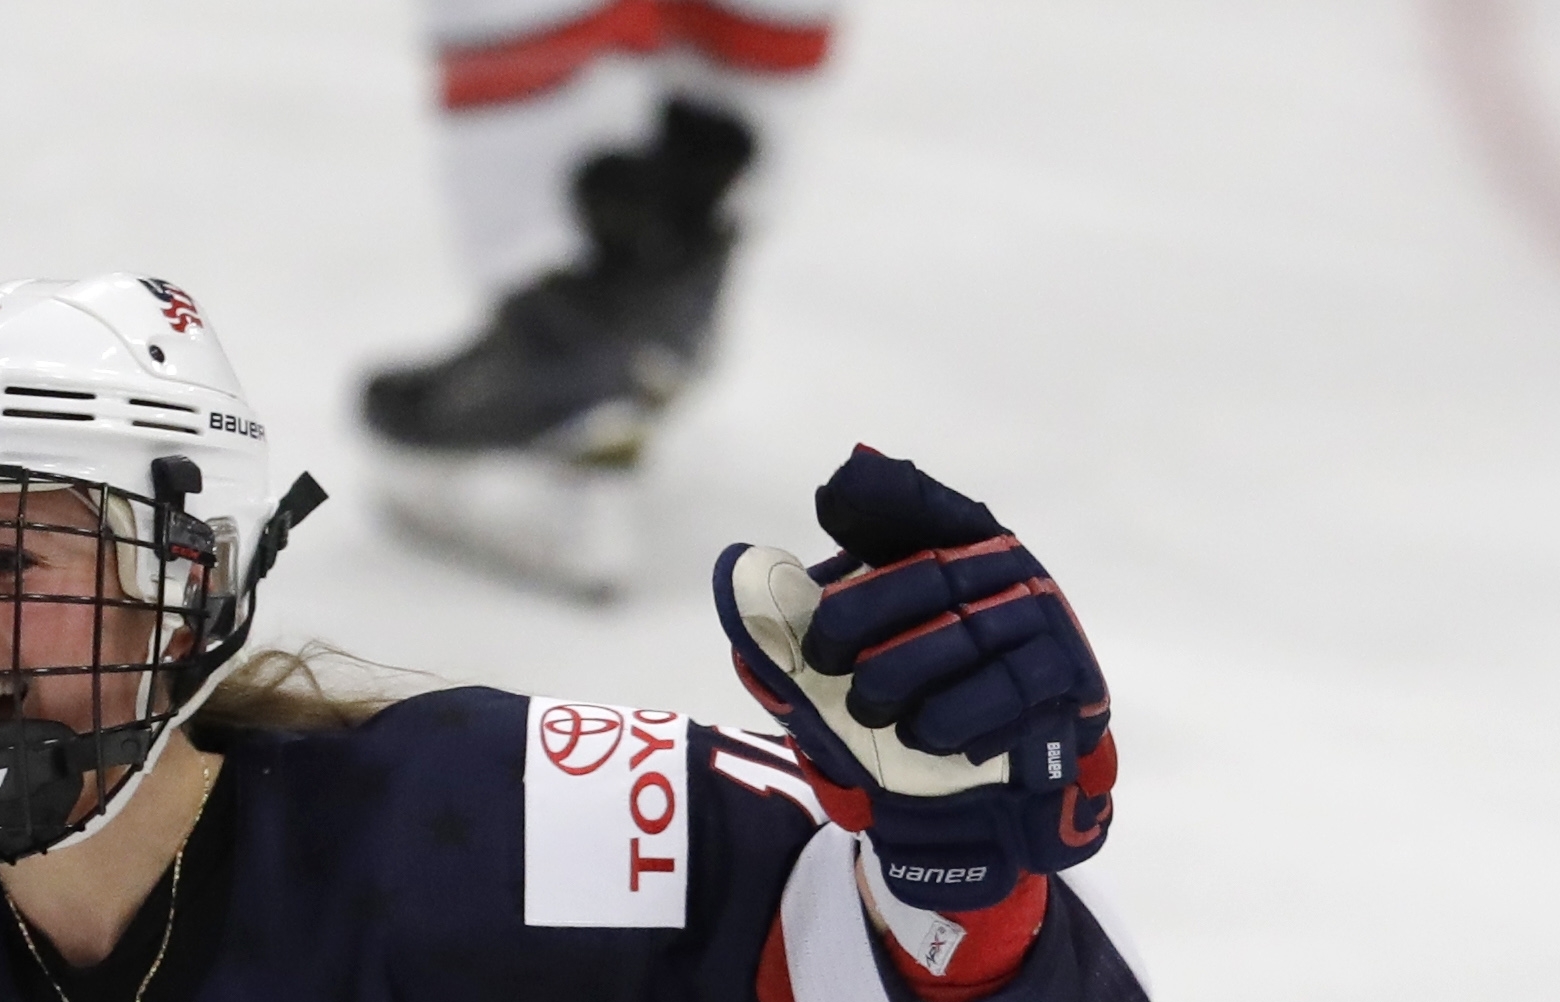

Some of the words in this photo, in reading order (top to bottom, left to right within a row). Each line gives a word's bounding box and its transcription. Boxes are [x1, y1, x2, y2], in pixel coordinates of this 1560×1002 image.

[209, 411, 267, 442] BAUER
[1046, 741, 1062, 780] BAUER
[888, 862, 988, 884] BAUER
